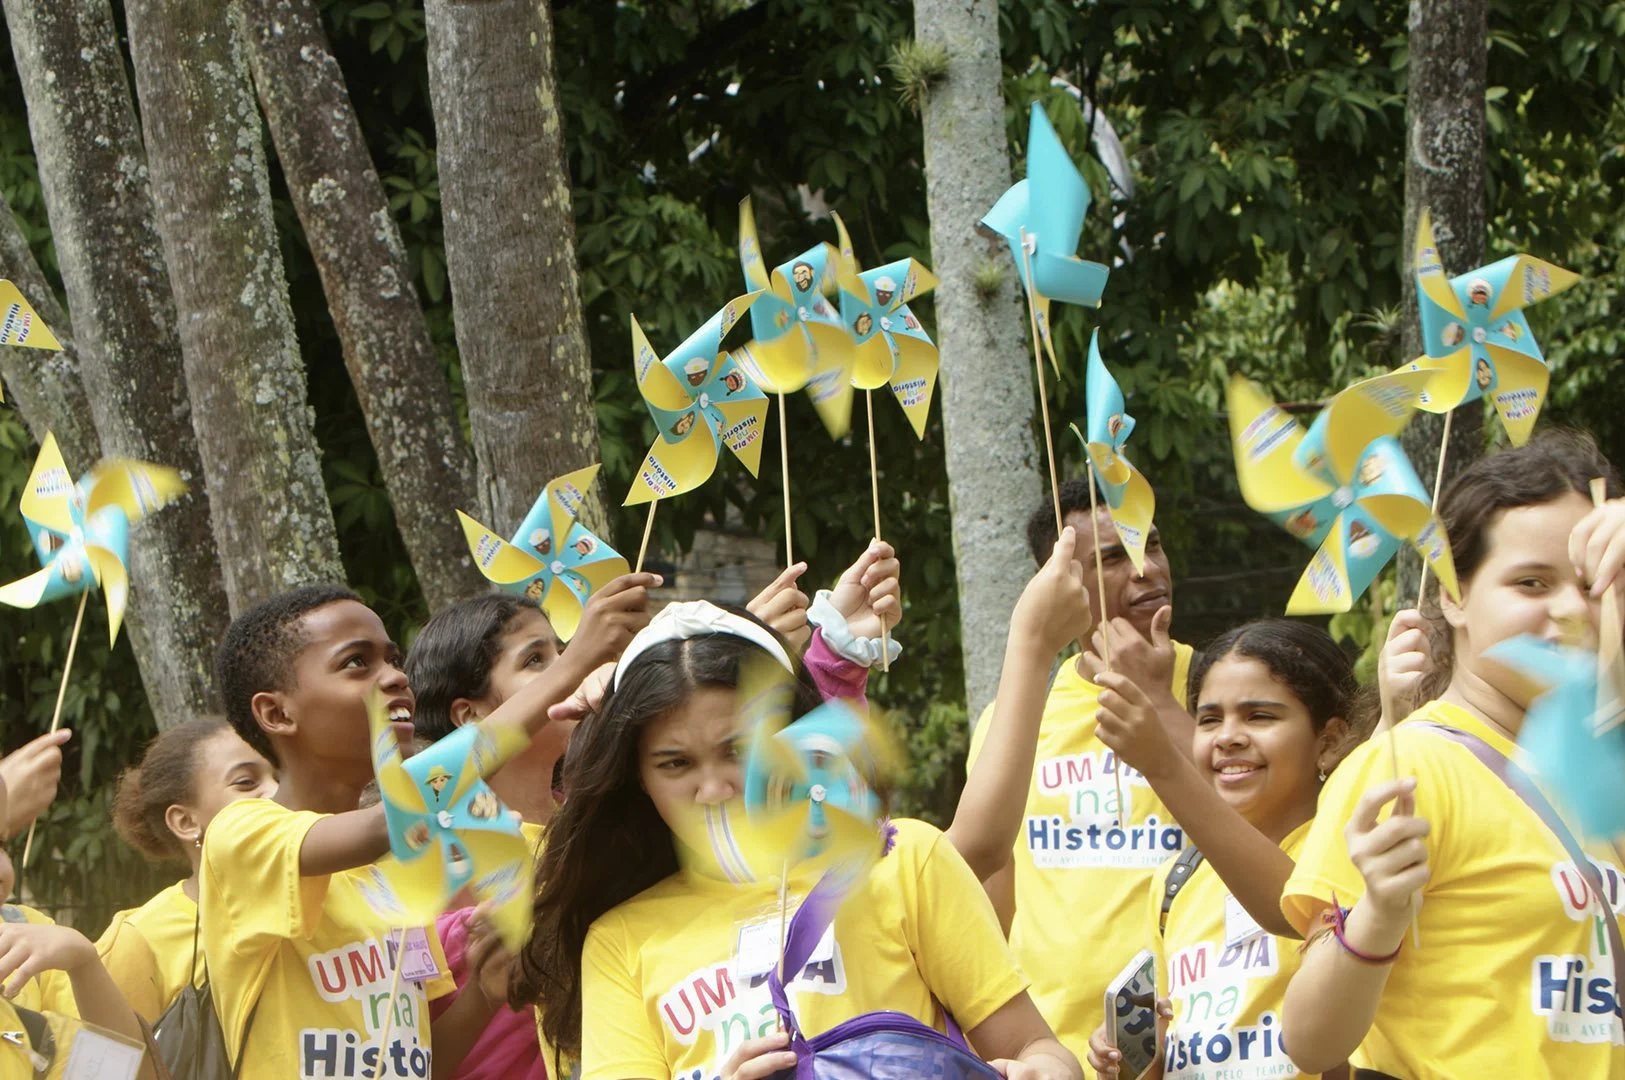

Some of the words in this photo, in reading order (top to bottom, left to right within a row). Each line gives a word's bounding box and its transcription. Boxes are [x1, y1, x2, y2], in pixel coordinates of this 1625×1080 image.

[723, 416, 757, 440] História
[746, 430, 759, 442] UM
[732, 440, 747, 450] DIA
[643, 471, 654, 486] DIA
[649, 456, 676, 490] História
[653, 484, 665, 496] UM
[1043, 758, 1092, 789] UM
[1076, 787, 1124, 815] na
[1029, 818, 1182, 850] História
[1218, 936, 1270, 970] DIA
[316, 945, 386, 994] UM
[664, 967, 736, 1036] UM
[1186, 985, 1239, 1024] na
[1540, 959, 1622, 1019] His
[369, 990, 415, 1030] na
[1165, 1015, 1288, 1073] istóri
[1256, 1063, 1294, 1077] TEMPO
